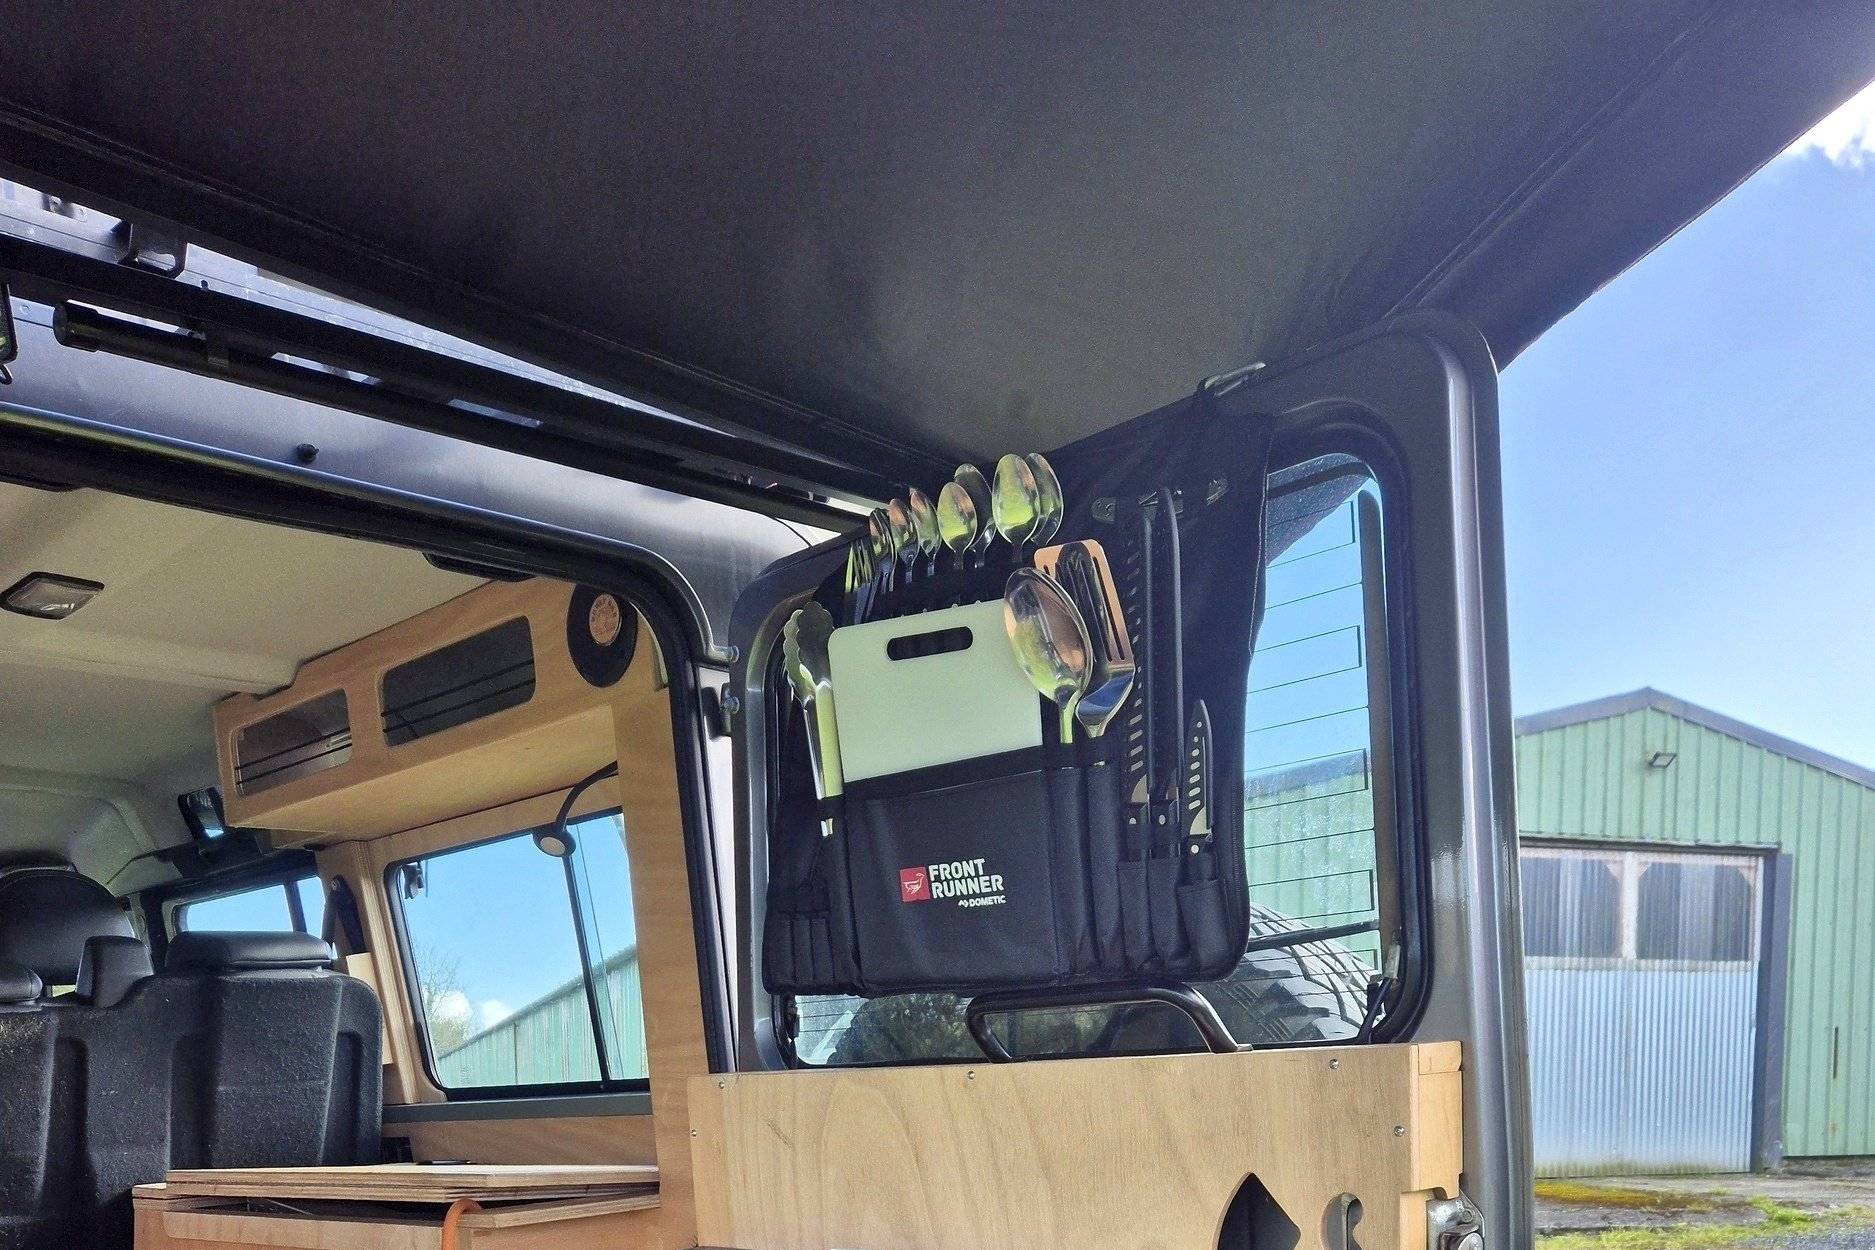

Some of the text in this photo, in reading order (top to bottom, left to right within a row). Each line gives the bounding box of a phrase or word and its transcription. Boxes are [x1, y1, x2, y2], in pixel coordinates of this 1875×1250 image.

[928, 858, 985, 881] FRONT
[931, 875, 1004, 899] RUNNER
[969, 895, 1006, 907] DOMETIC
